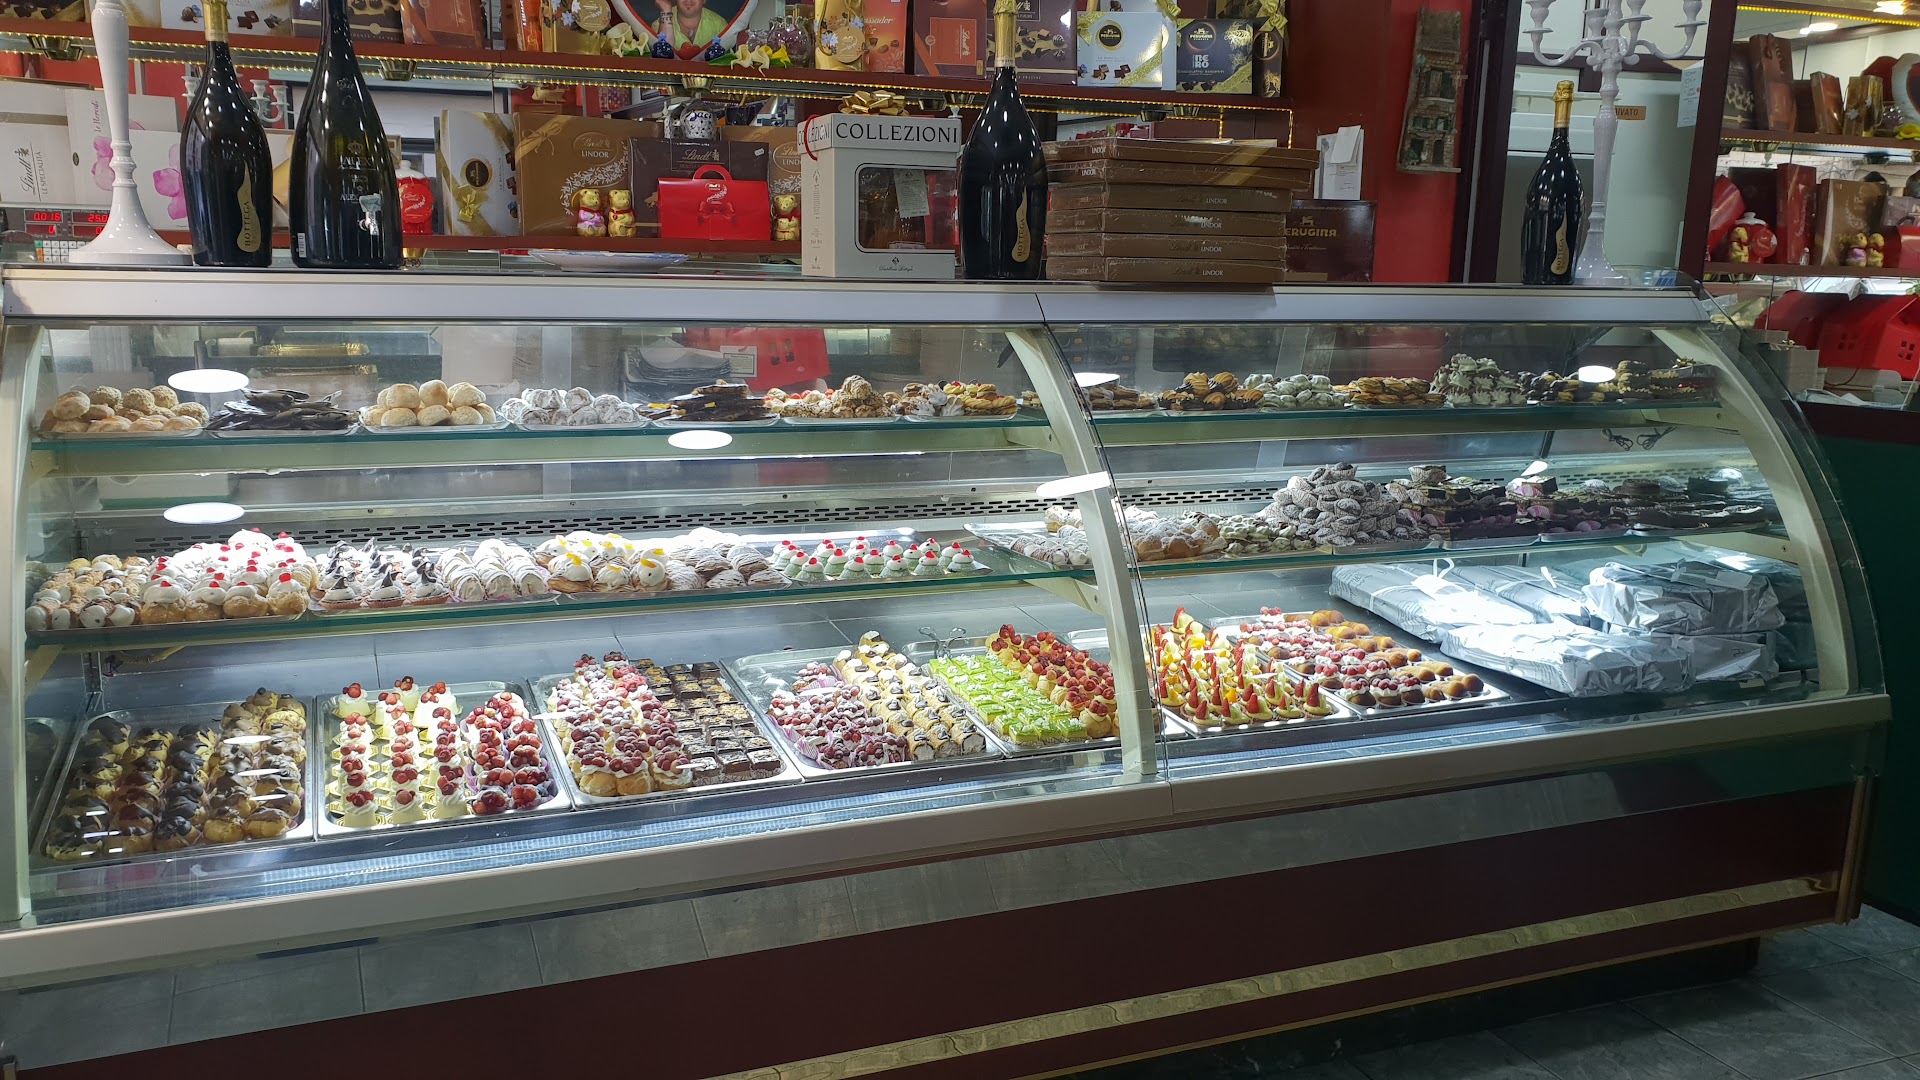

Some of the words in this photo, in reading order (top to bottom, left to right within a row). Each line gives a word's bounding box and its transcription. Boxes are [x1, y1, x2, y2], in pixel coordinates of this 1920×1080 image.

[797, 123, 830, 145] COLEZIONI
[835, 122, 959, 144] COLLEZIONI
[581, 150, 609, 158] LINDOR
[681, 148, 712, 160] Lindt
[18, 157, 36, 195] Lindt
[243, 200, 251, 246] BOTTEGA
[1285, 227, 1337, 238] ERUGINA
[1017, 218, 1025, 257] BOTTEGA
